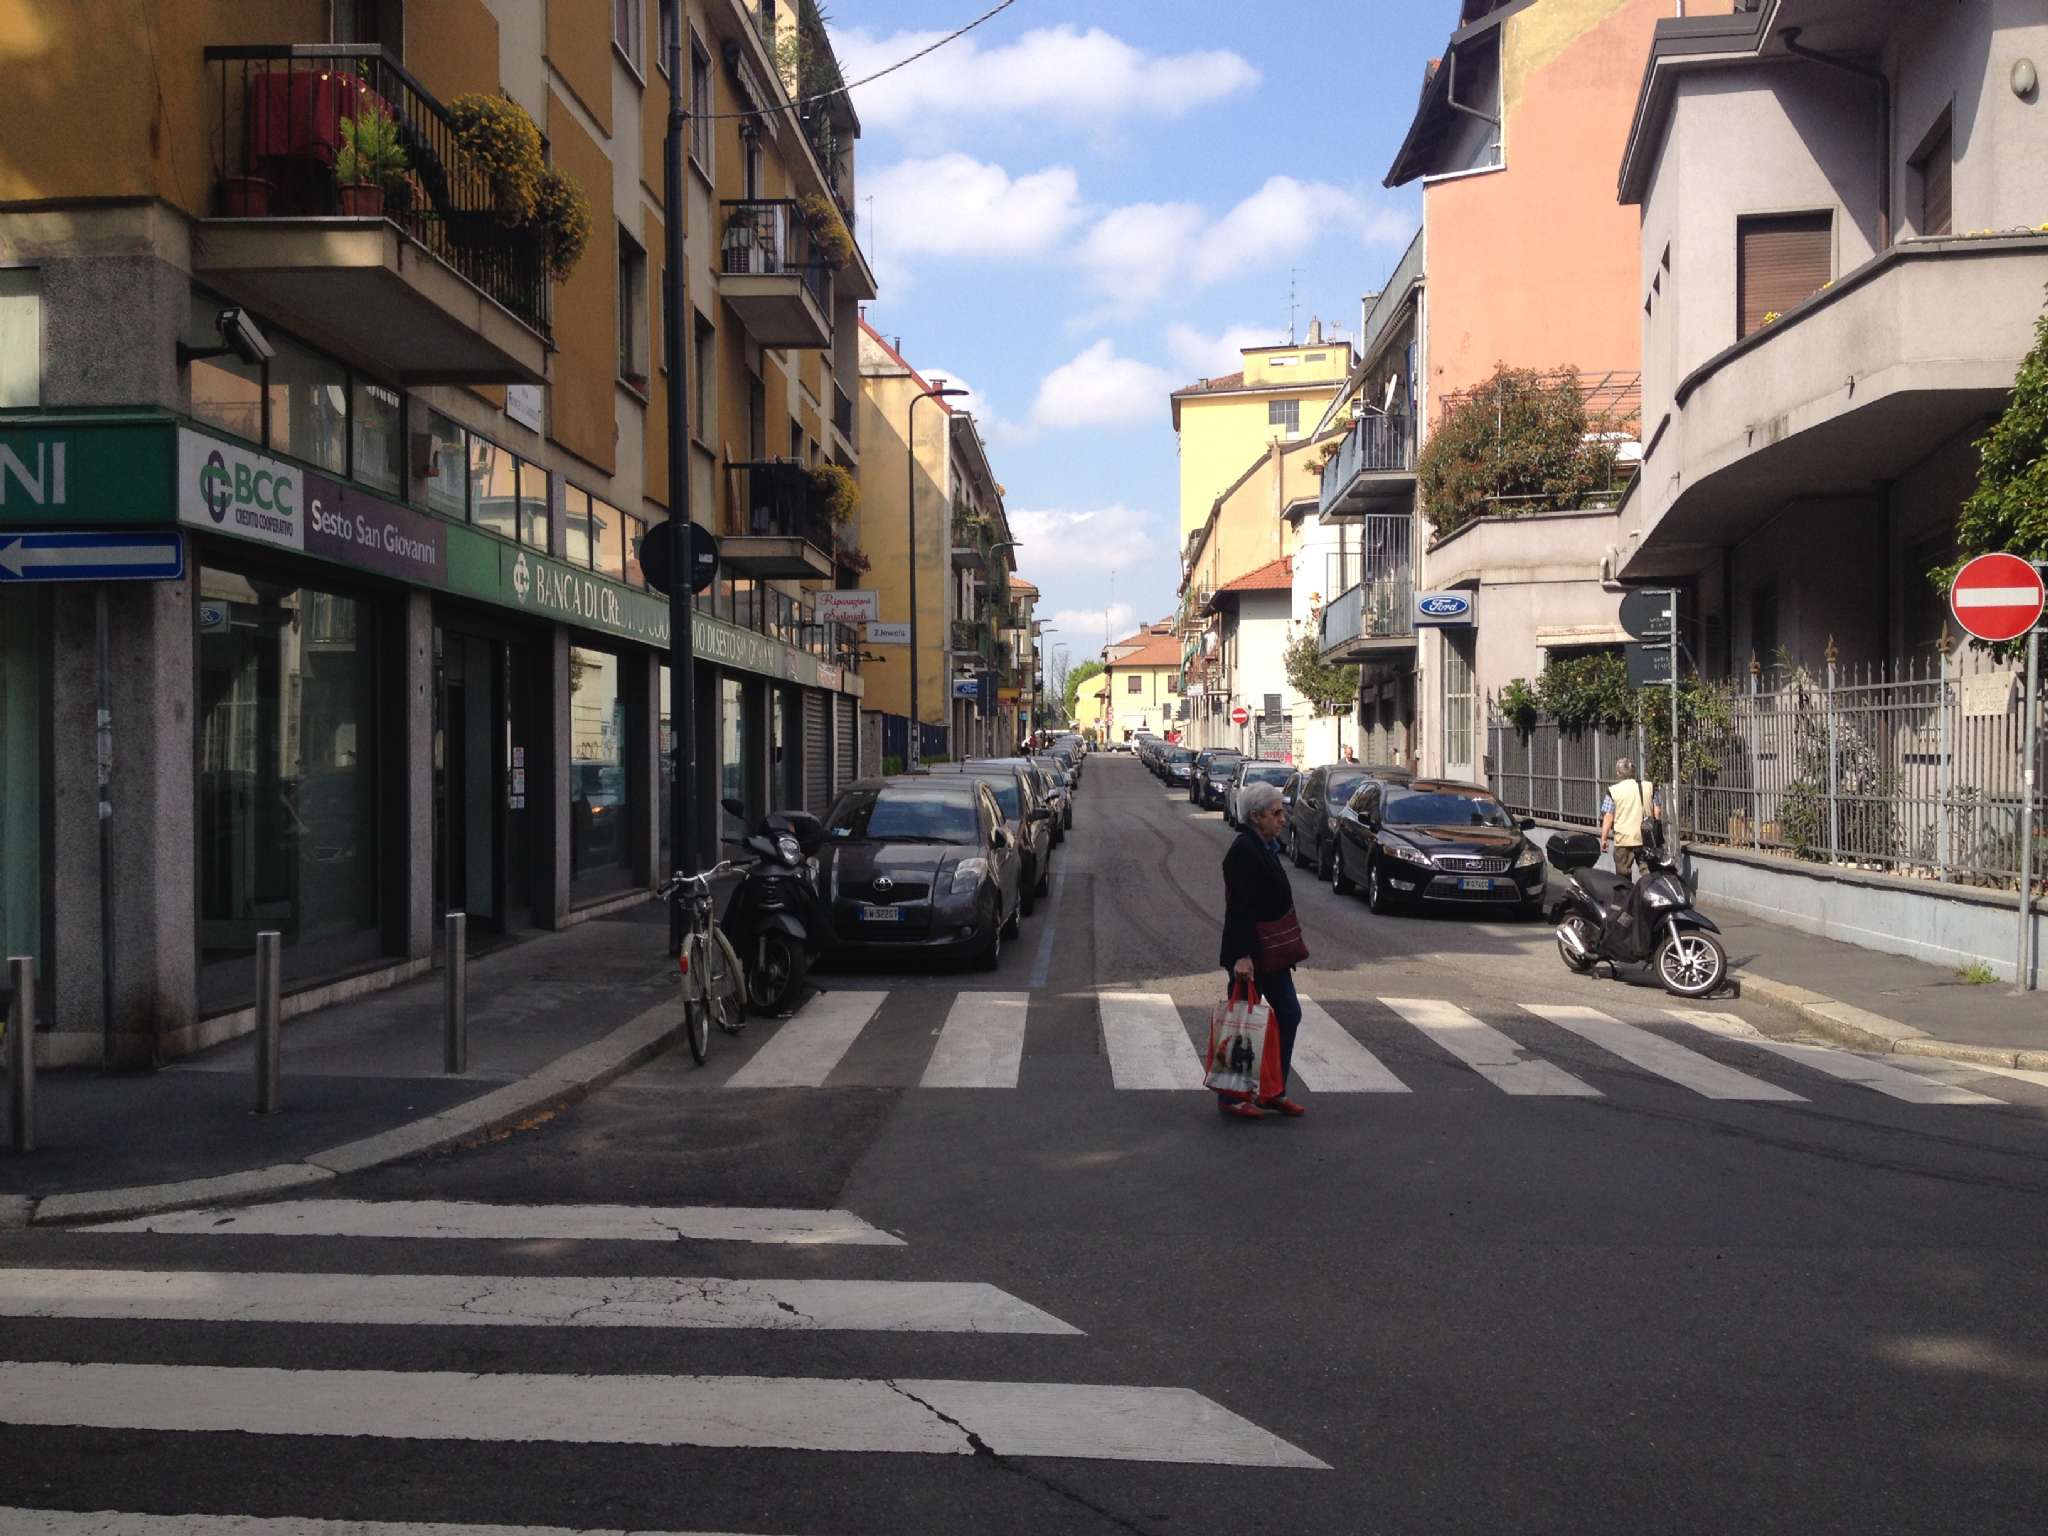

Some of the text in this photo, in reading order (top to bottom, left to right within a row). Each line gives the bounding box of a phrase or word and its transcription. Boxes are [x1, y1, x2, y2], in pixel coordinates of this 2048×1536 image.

[0, 441, 67, 505] NI
[235, 463, 293, 516] BCC
[311, 500, 436, 564] Sesto San Giovanni
[536, 565, 581, 615] BANCA
[585, 581, 597, 621] DI
[707, 625, 716, 655] DI
[716, 629, 737, 660] SESTO
